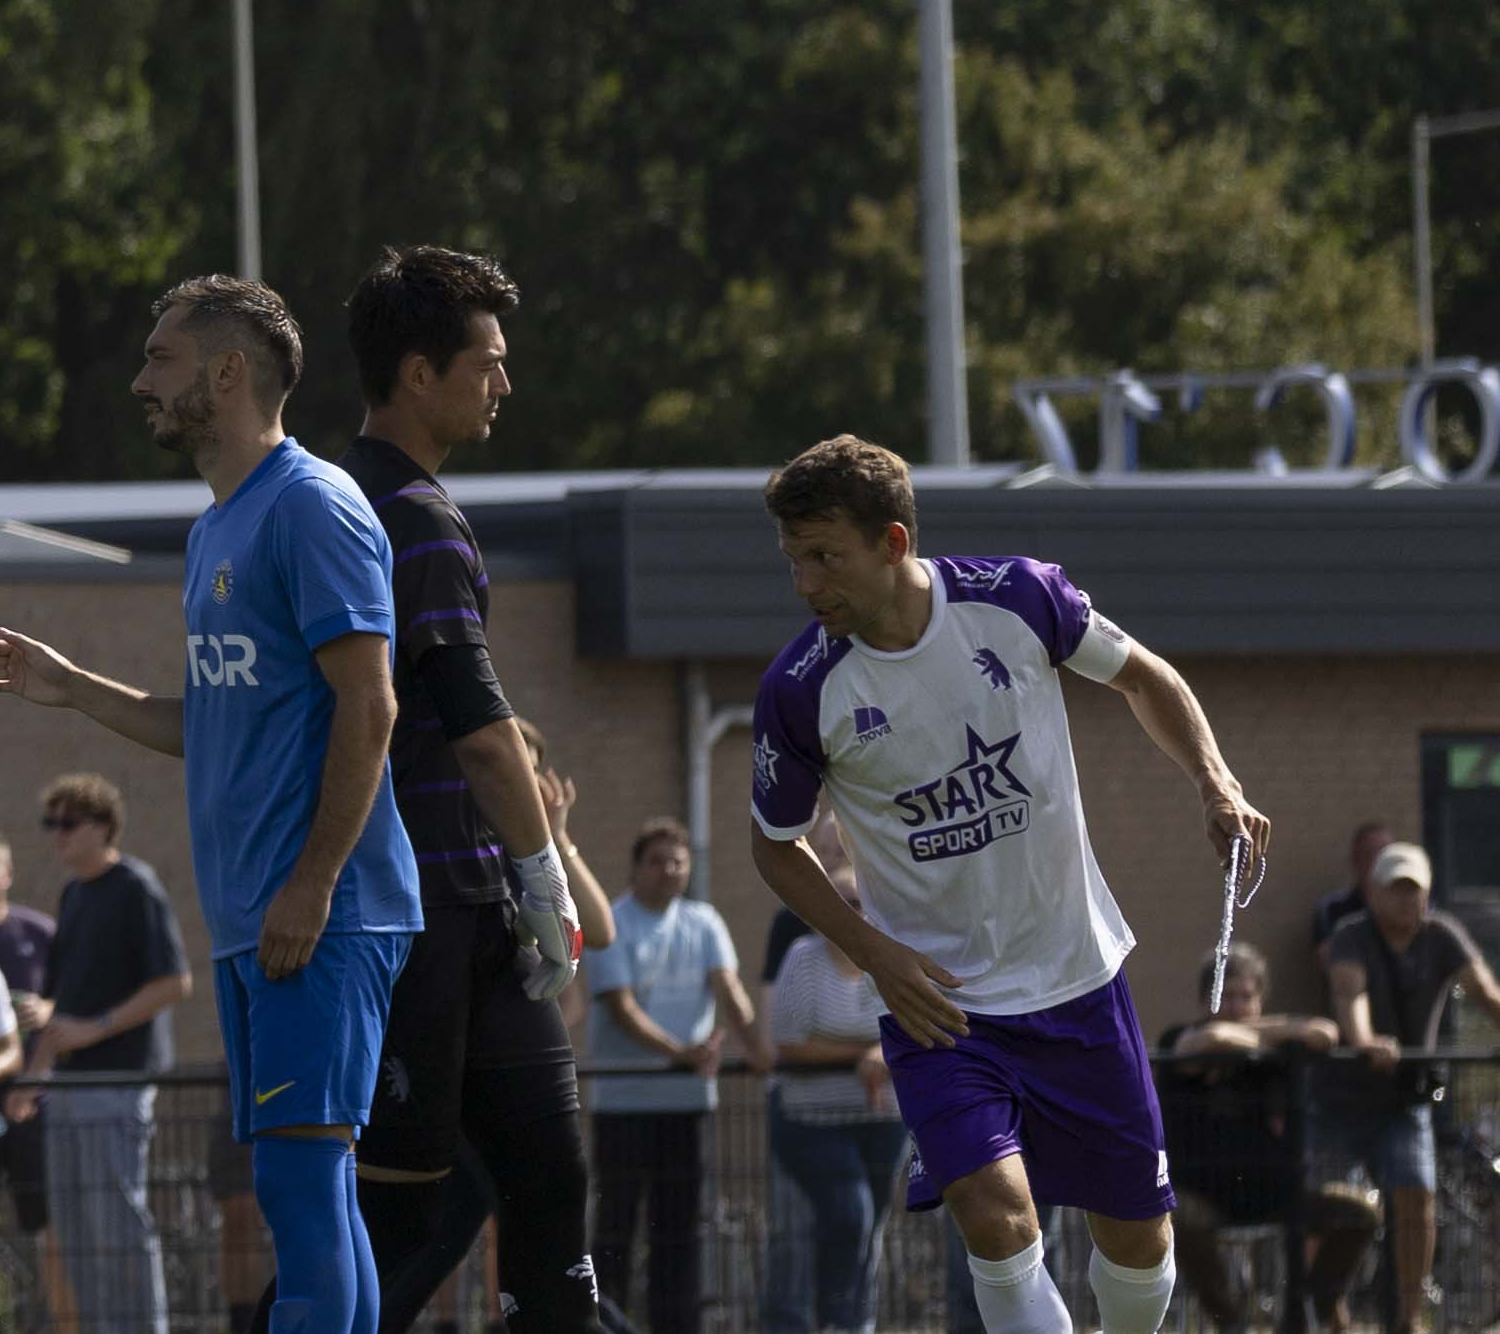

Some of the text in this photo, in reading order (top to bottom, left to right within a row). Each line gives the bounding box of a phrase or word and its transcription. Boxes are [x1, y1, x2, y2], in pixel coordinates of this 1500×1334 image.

[858, 723, 892, 745] nova
[893, 763, 1011, 827] STAR
[914, 808, 1024, 857] SPORT TV
